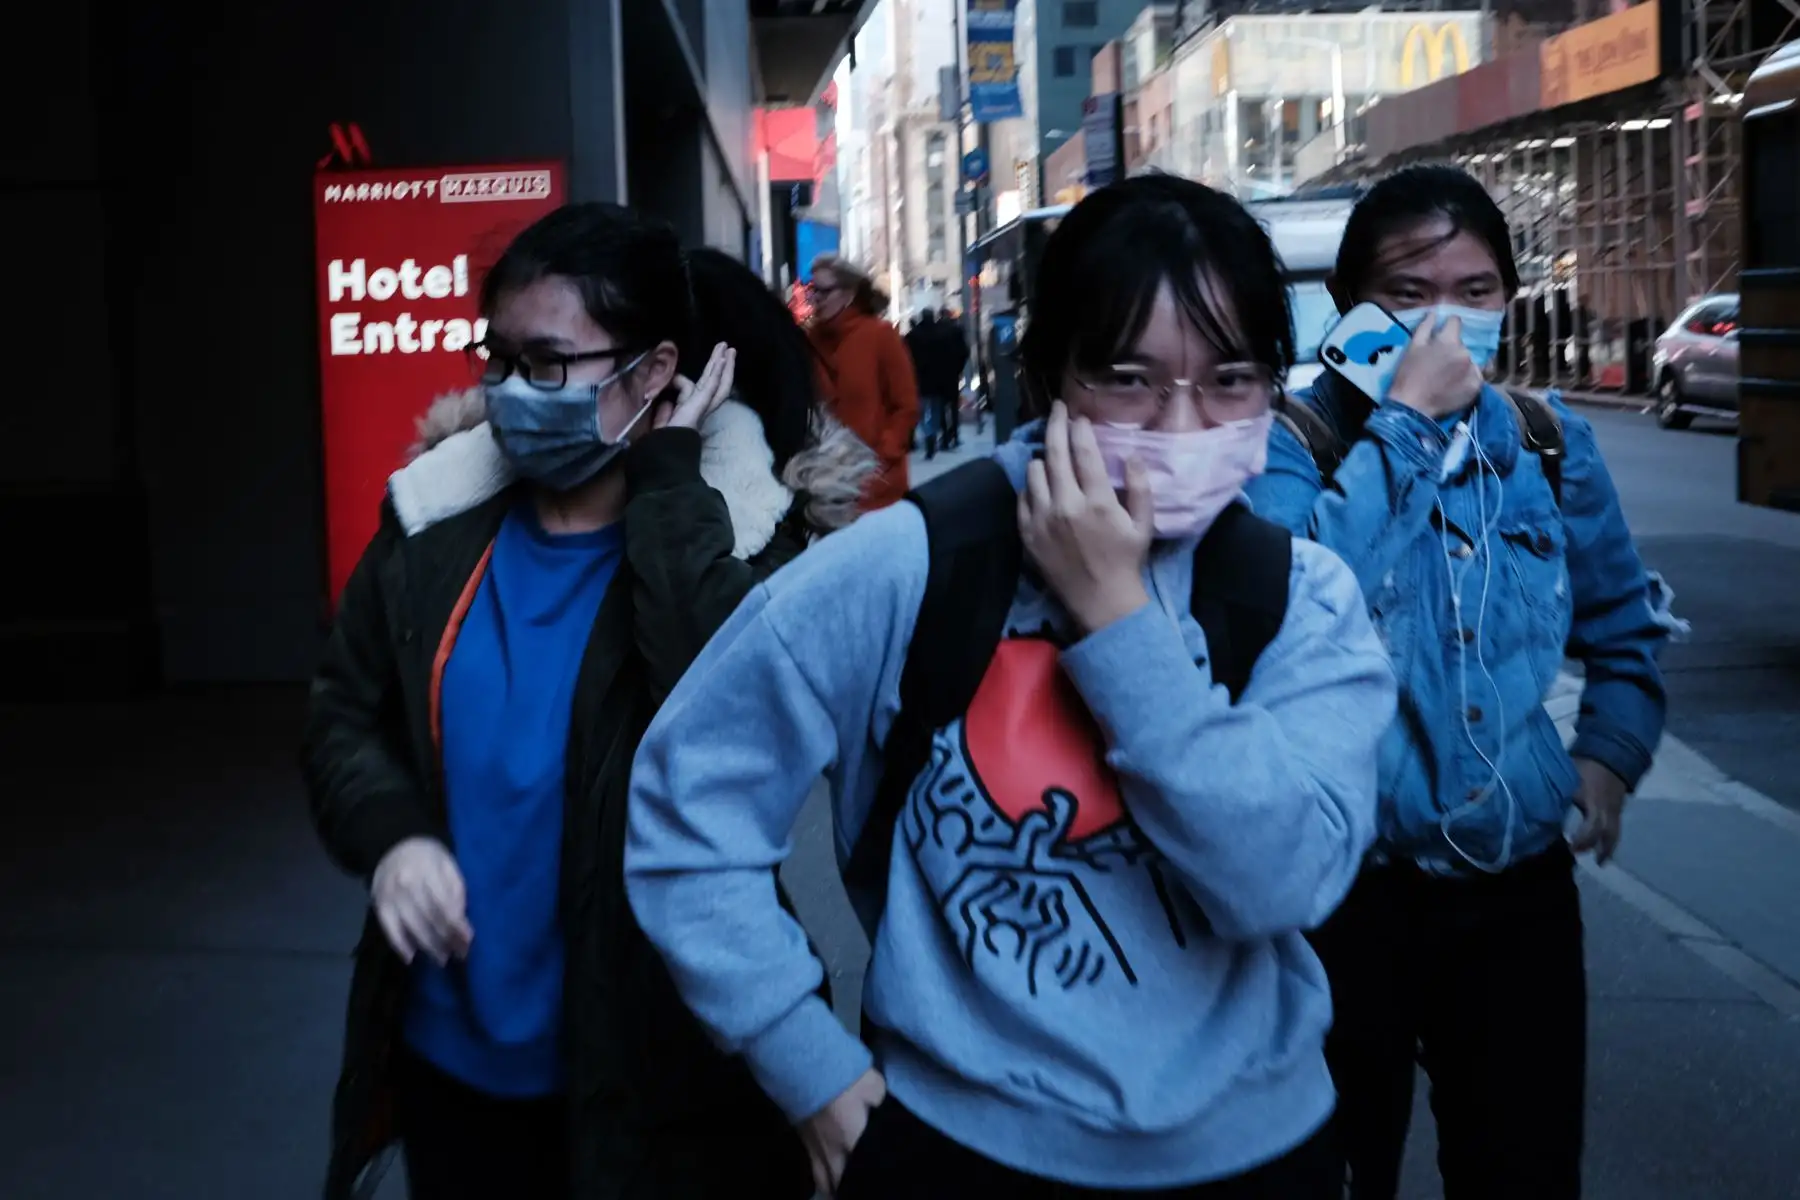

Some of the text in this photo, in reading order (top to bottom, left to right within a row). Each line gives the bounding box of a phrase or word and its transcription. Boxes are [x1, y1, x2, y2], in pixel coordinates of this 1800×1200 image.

[324, 174, 548, 203] MARRIOTT MARQUIS
[328, 254, 468, 302] Hotel
